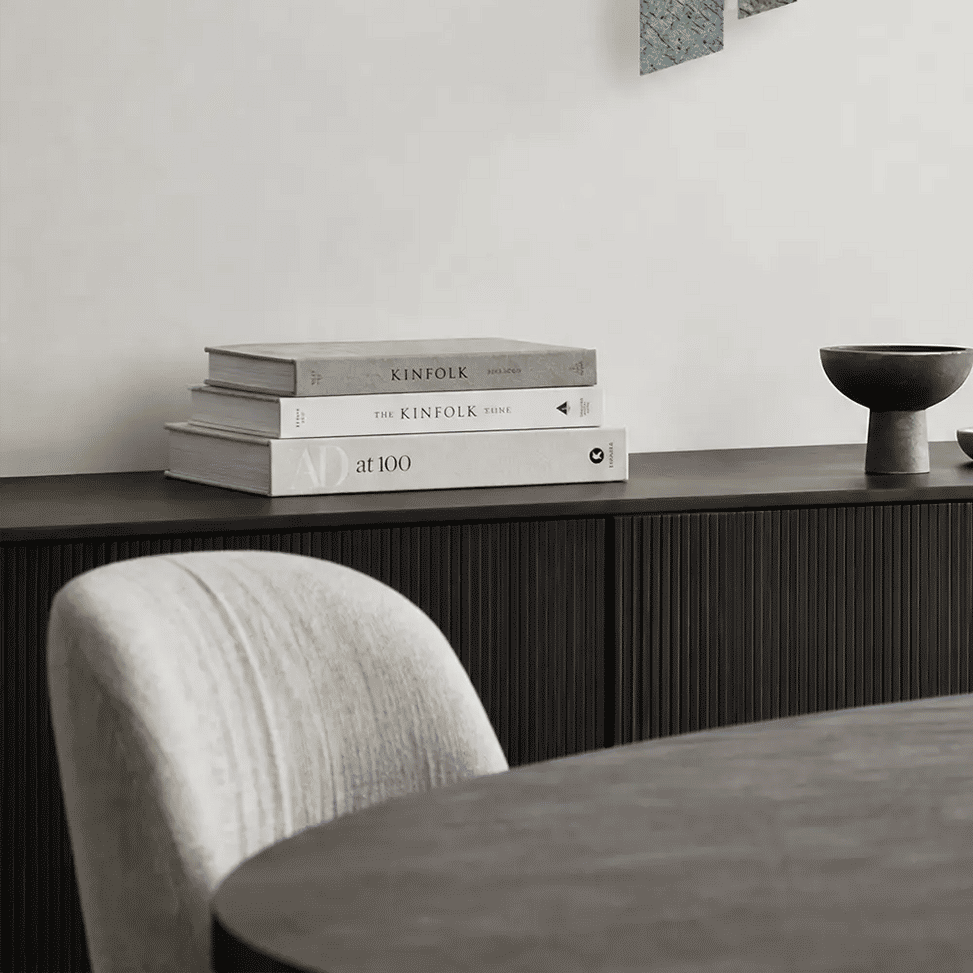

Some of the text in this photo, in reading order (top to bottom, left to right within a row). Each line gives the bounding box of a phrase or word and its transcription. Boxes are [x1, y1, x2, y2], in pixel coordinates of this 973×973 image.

[390, 366, 468, 381] KINFOLK
[374, 411, 394, 419] THE
[400, 405, 477, 420] KINFOLK
[356, 457, 374, 474] at
[377, 454, 412, 473] 100
